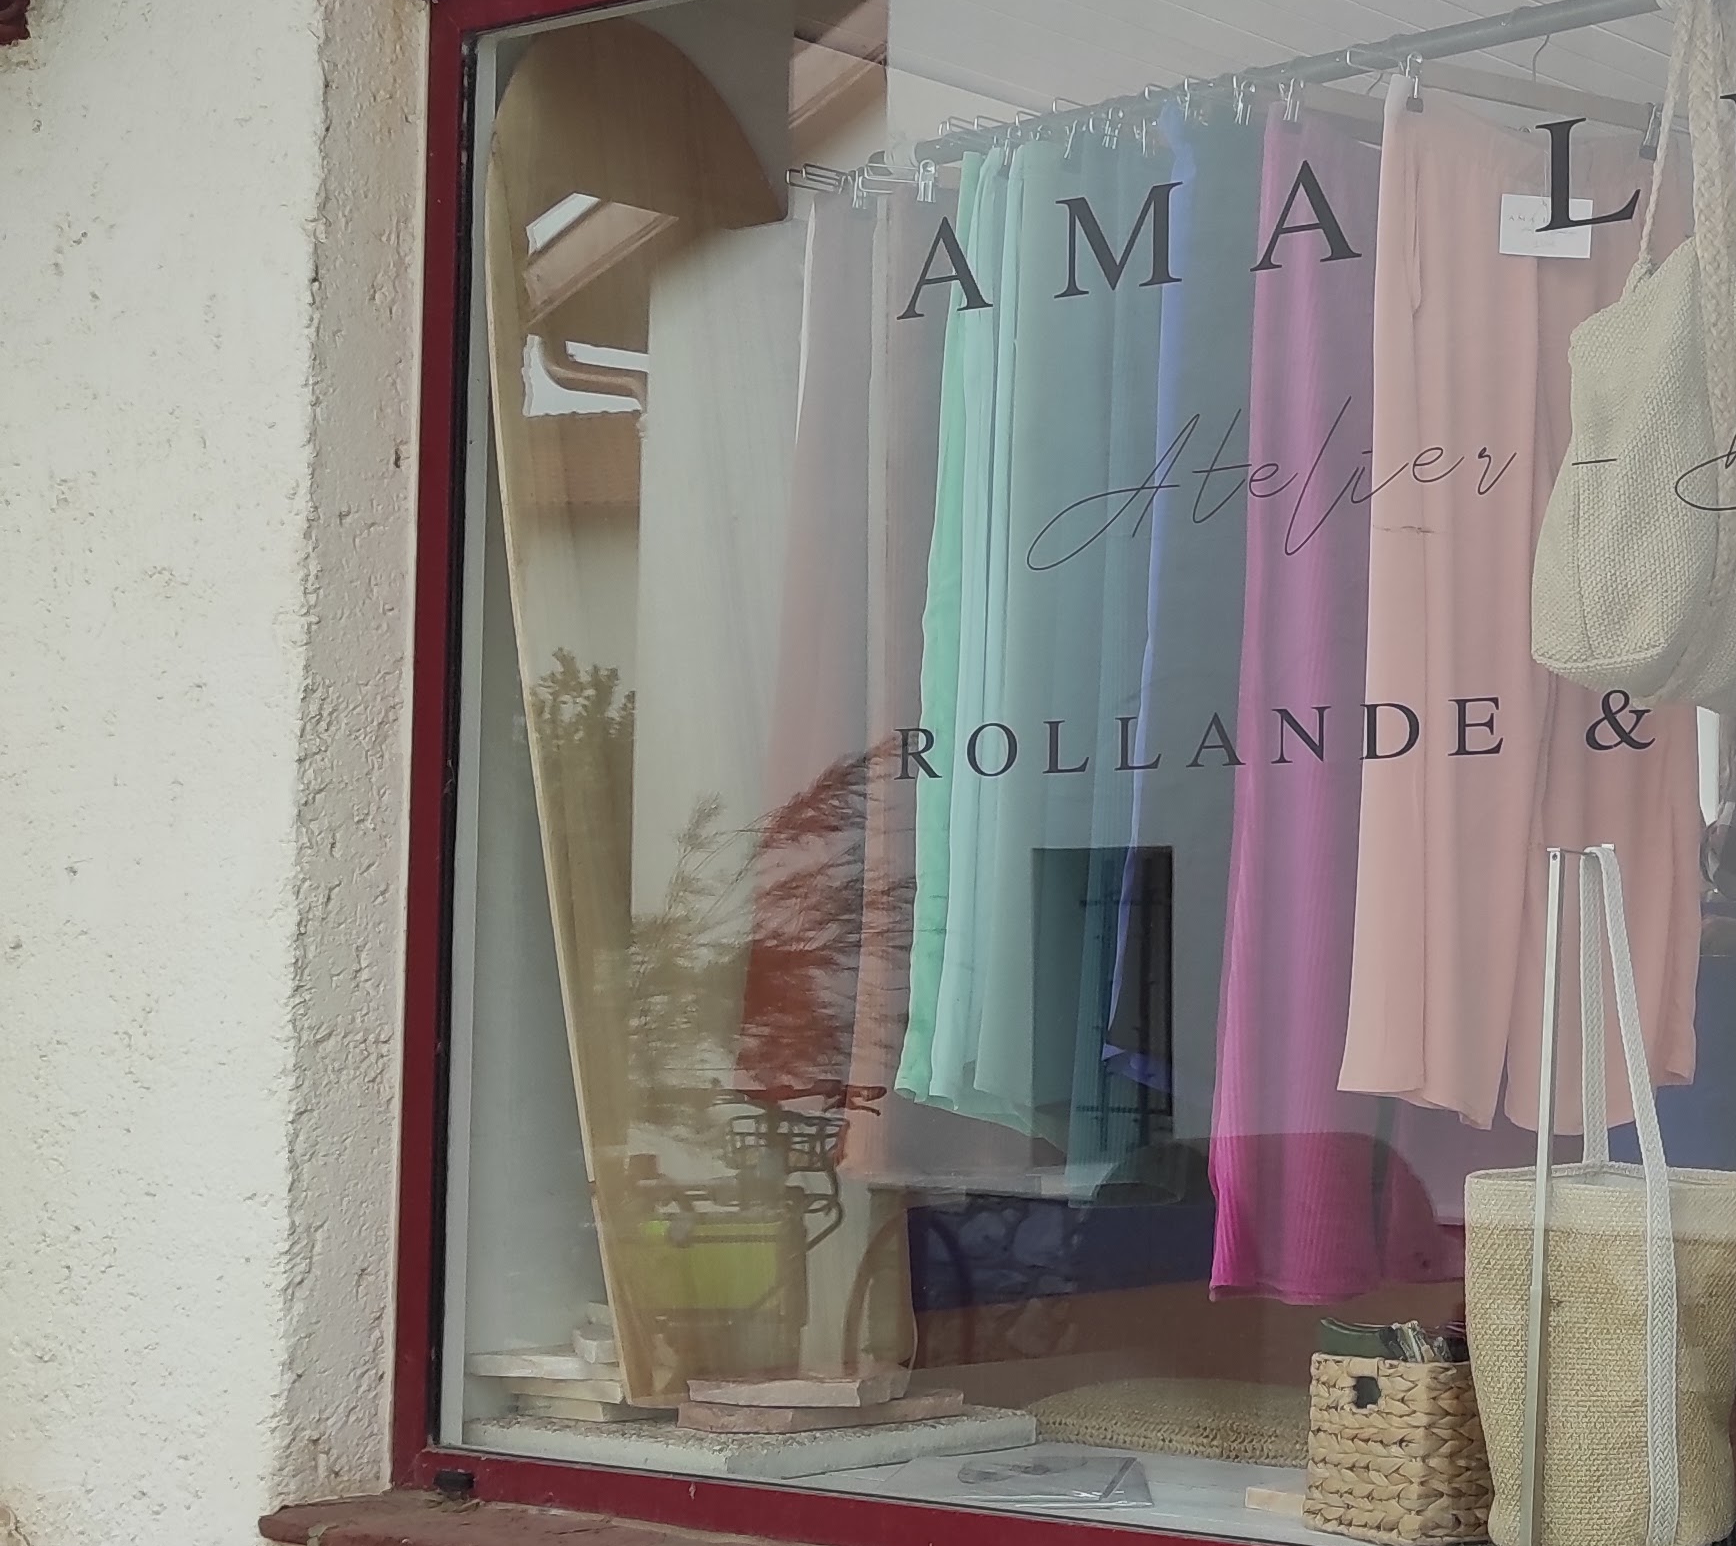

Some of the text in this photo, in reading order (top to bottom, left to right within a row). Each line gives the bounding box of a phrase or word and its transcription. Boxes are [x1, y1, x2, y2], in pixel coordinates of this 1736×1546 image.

[897, 159, 1363, 320] AMA
[1026, 395, 1517, 571] Atelier
[894, 695, 1506, 781] ROLLANDE
[1584, 689, 1656, 751] &
